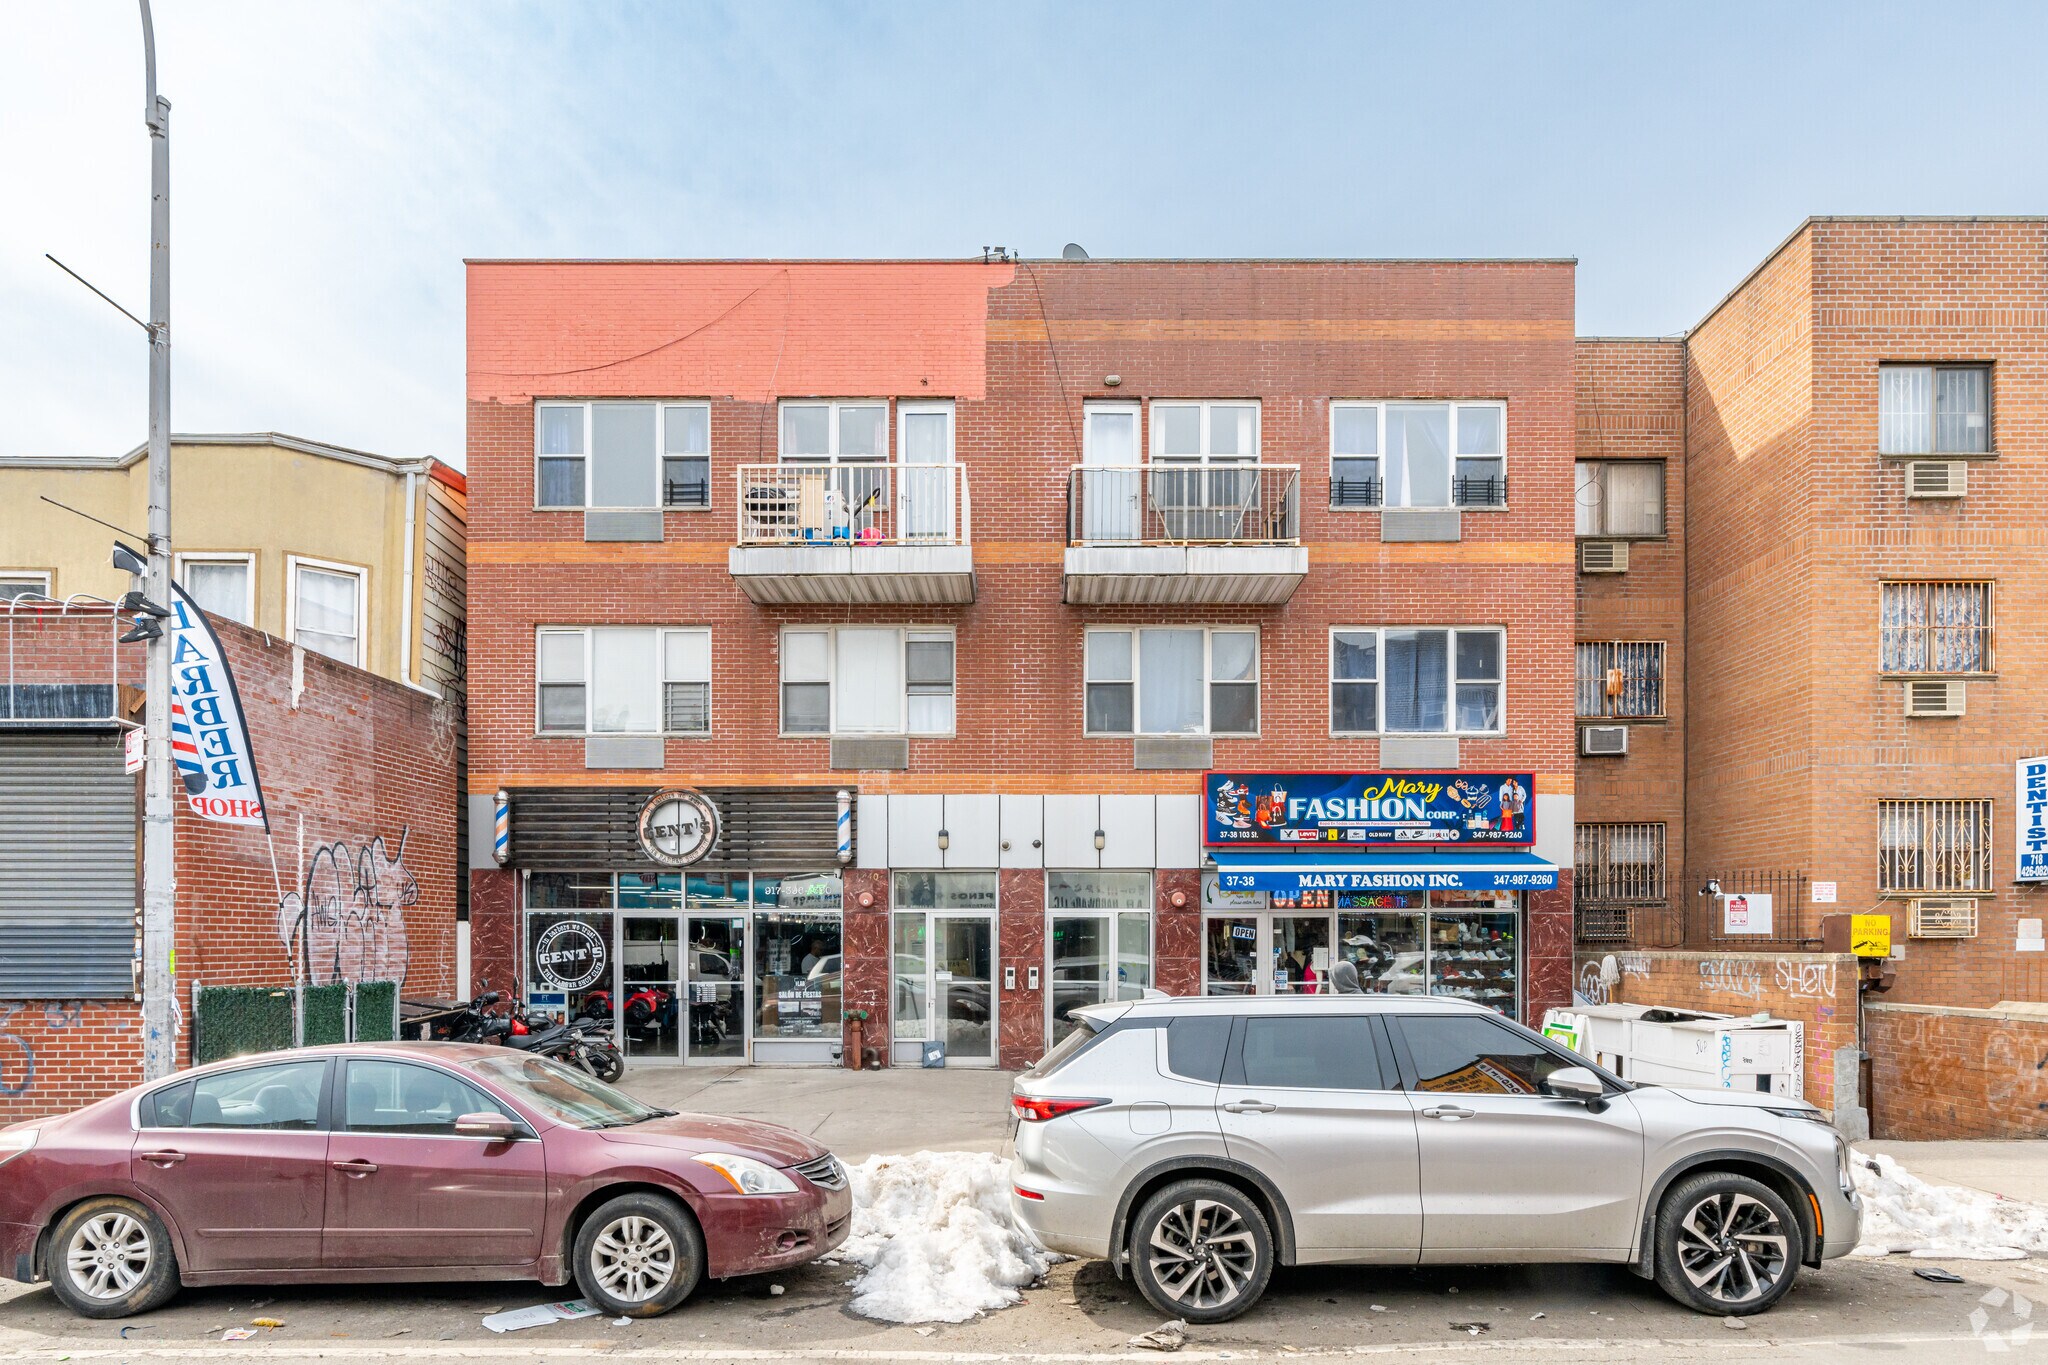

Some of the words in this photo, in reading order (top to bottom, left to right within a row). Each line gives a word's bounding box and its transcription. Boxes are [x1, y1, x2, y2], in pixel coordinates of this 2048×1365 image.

[1364, 777, 1443, 803] Mary
[1288, 797, 1427, 821] FASHION
[1427, 810, 1460, 820] CORP.
[2026, 763, 2048, 852] DENTIST
[643, 818, 711, 840] GENT'S
[1472, 831, 1523, 839] 347-987-9260
[2030, 854, 2044, 866] 718
[2021, 865, 2048, 878] 426-082
[1226, 875, 1255, 887] 37-38
[1299, 874, 1348, 888] MARY
[1350, 874, 1425, 887] FASHION
[1428, 874, 1463, 887] INC.
[1493, 874, 1553, 885] 347-987-9260
[1273, 890, 1329, 908] OPEN
[1865, 919, 1877, 927] NO
[1235, 927, 1255, 939] OPEN
[1853, 928, 1889, 936] PARKING
[539, 942, 603, 965] GENT'S
